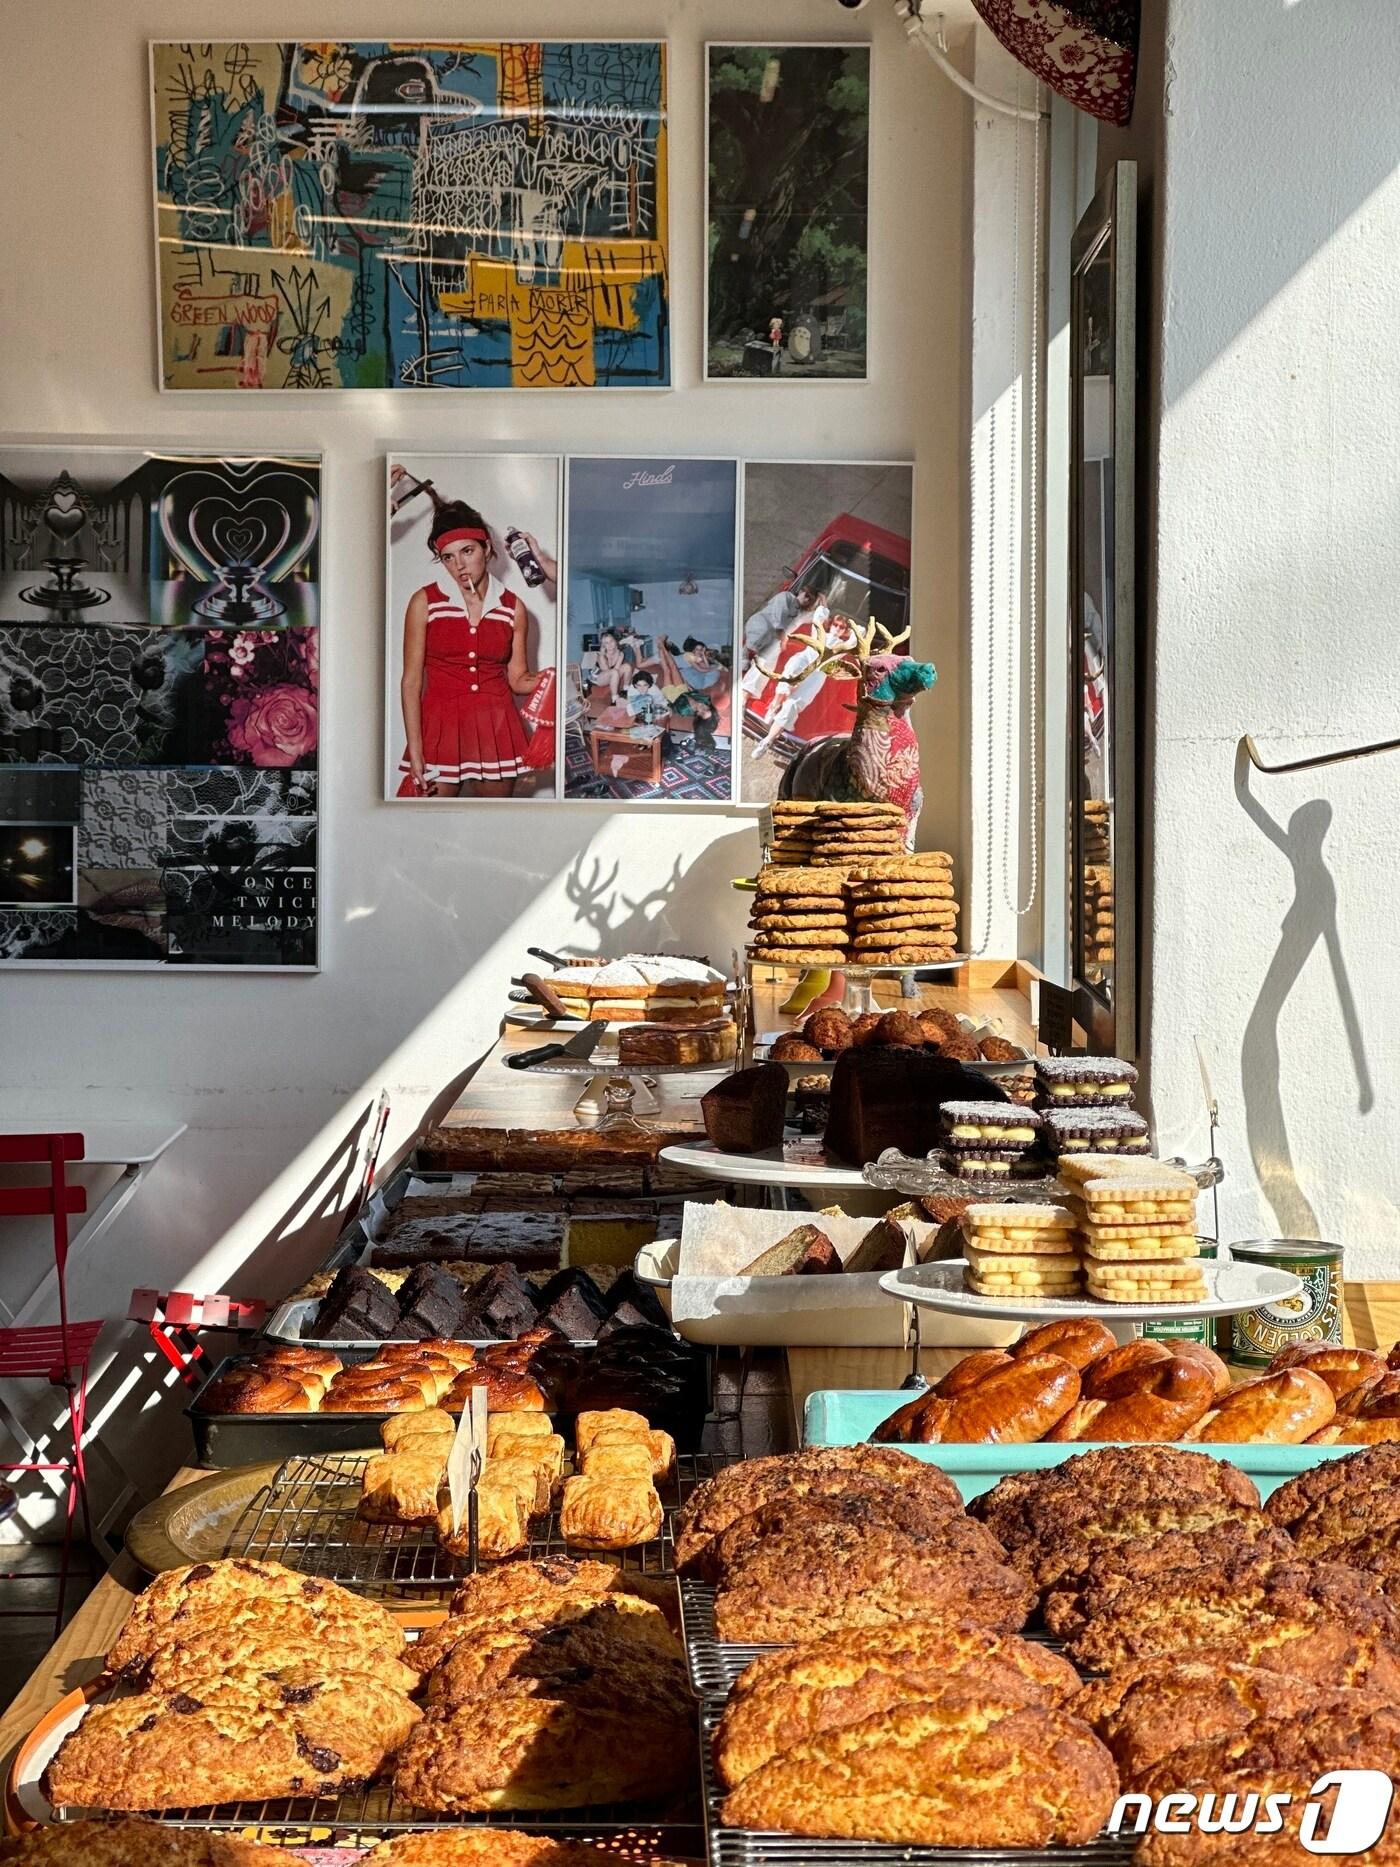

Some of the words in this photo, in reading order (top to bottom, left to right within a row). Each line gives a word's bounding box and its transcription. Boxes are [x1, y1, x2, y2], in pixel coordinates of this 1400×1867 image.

[170, 302, 227, 323] GREEN
[233, 302, 275, 324] WOOD
[479, 292, 520, 314] PARA
[622, 464, 676, 489] Hinds
[245, 877, 312, 889] ONCE
[212, 916, 316, 927] MELODY
[1321, 1270, 1342, 1328] LYLE'S
[1252, 1324, 1324, 1348] GOLDEN
